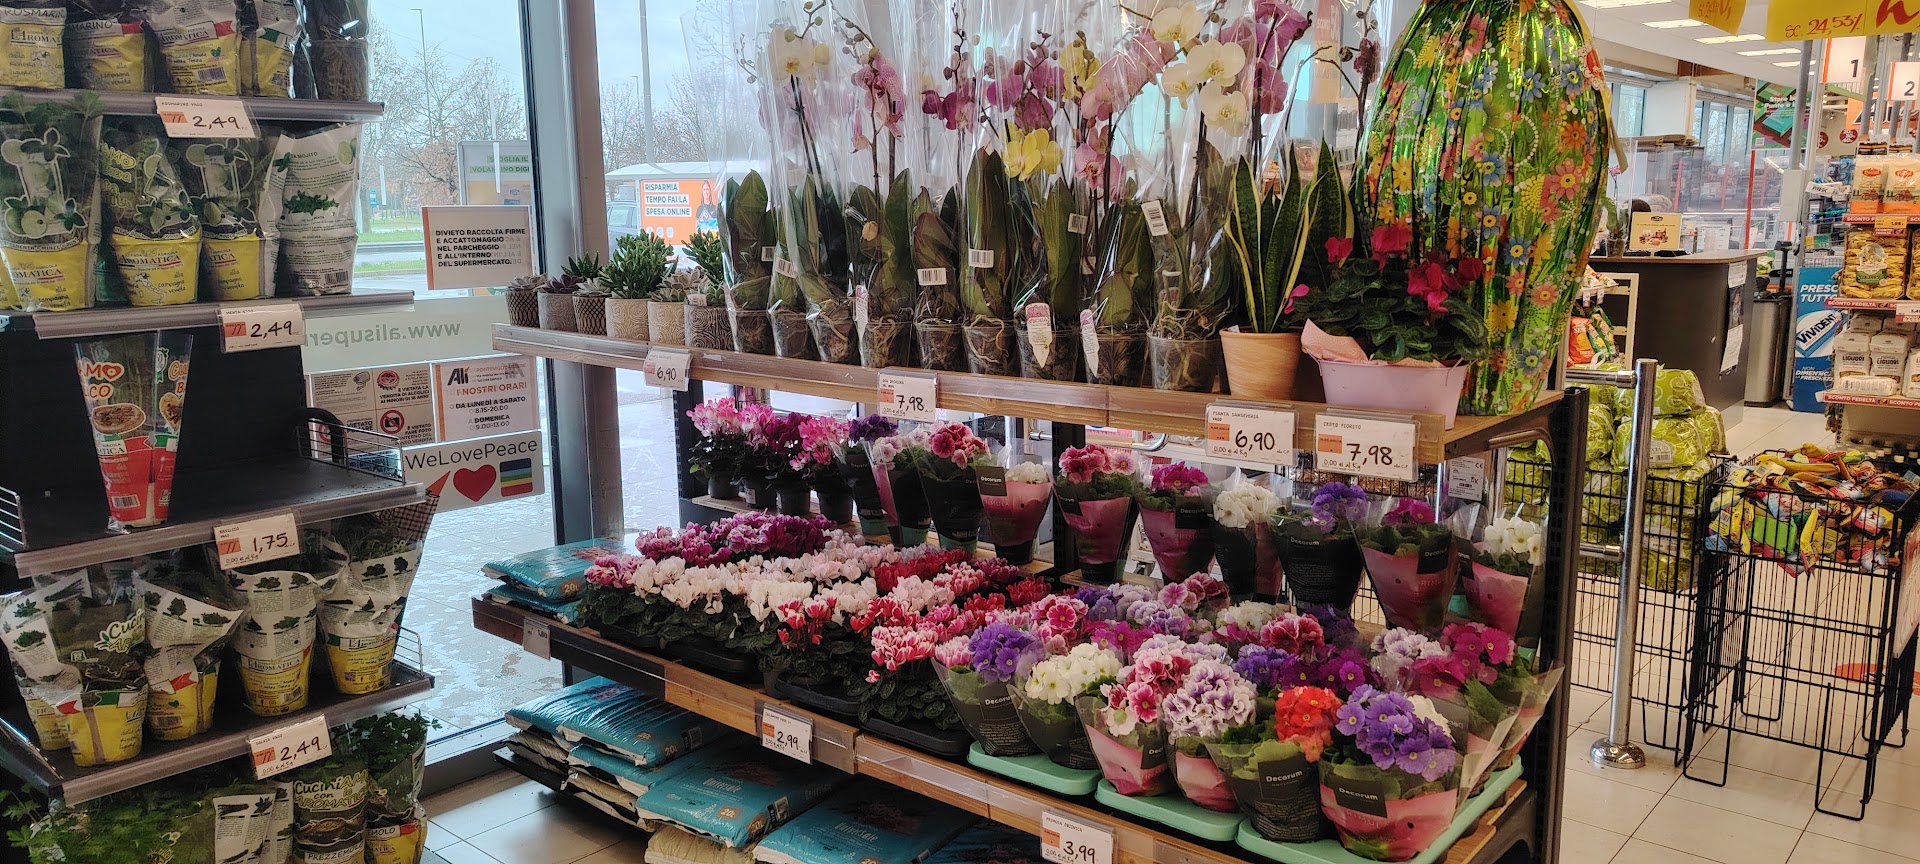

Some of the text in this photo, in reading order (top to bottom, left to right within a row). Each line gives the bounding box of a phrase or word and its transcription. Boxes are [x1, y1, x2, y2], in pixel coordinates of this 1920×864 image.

[1850, 59, 1859, 78] 1
[1904, 81, 1915, 97] 2
[192, 116, 241, 130] 2,49
[645, 183, 678, 191] RISPARMIA
[645, 195, 688, 203] TEMPO FAI LA
[646, 208, 690, 216] SPESA ONLINE
[443, 236, 504, 244] ACCATTONAGGIO
[250, 321, 292, 339] 2,49
[447, 365, 470, 386] Ali
[657, 366, 677, 381] 6,90
[462, 385, 497, 396] NOSTRI
[498, 381, 527, 392] ORARI
[467, 399, 492, 408] LUNEDÌ
[499, 396, 526, 404] SABATO
[896, 395, 925, 412] 7,98
[474, 414, 511, 424] DOMENICA
[1235, 430, 1275, 451] 6,90
[405, 440, 538, 470] WeLovePeace
[1239, 448, 1248, 458] Kg
[1346, 443, 1393, 466] 7,98
[1352, 461, 1361, 472] Kg
[980, 475, 1002, 483] Decorum
[219, 526, 240, 534] BASILICO
[253, 532, 288, 554] 1,75
[1290, 535, 1320, 546] Decorum
[777, 731, 799, 751] 2,99
[280, 736, 321, 762] 2,49
[1265, 769, 1303, 783] Decorum
[1338, 787, 1379, 801] Decorum
[1046, 817, 1063, 826] PRIMULA
[1063, 841, 1096, 864] 3,99
